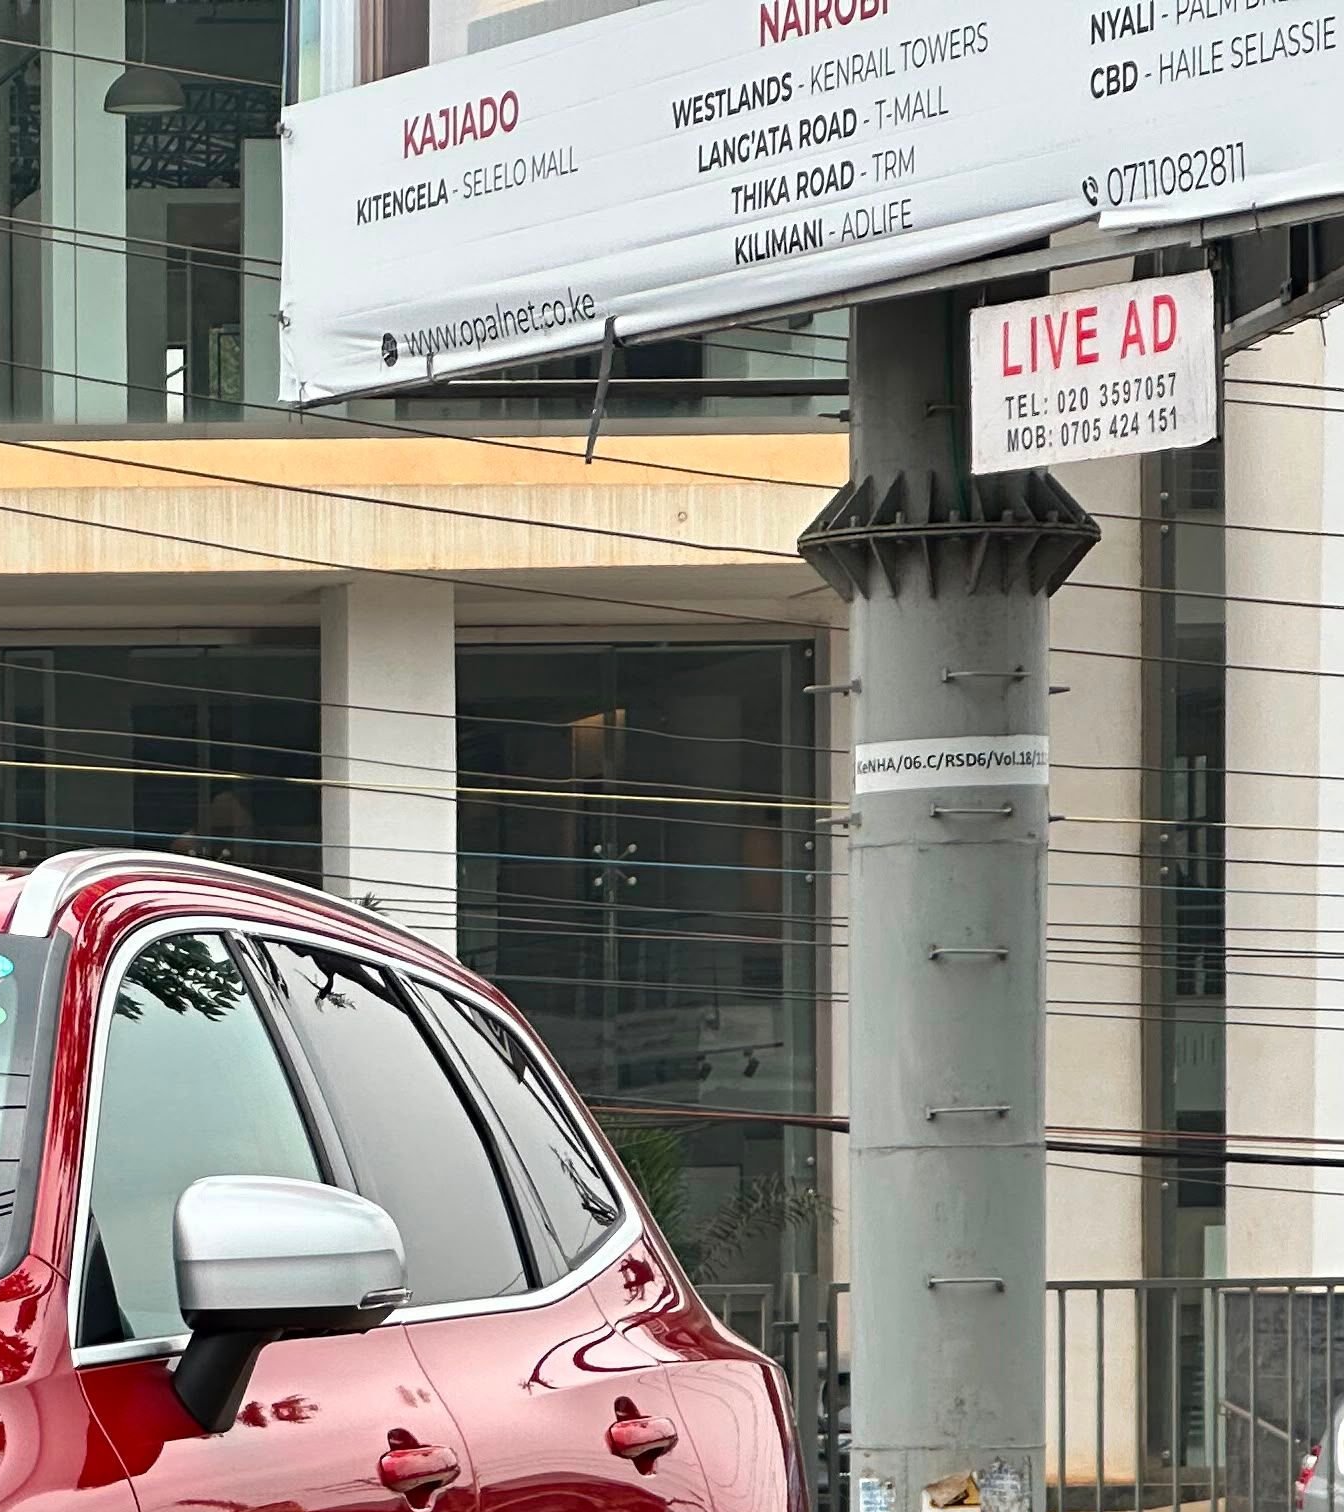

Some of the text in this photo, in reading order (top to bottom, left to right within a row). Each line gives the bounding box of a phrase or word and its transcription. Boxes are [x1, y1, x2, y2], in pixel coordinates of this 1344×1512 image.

[1090, 0, 1155, 45] NYALI
[1090, 60, 1139, 99] CBD
[1159, 40, 1224, 85] HAILE
[1230, 16, 1337, 69] SELASSIE
[672, 72, 792, 129] WESTLANDS
[811, 46, 896, 95] KENRAIL
[899, 22, 989, 71] TOWERS
[403, 90, 520, 159] KAJIADO
[698, 123, 793, 173] LANG'ATA
[799, 107, 857, 149] ROAD
[875, 85, 949, 130] T-MALL
[356, 178, 448, 226] KITENGELA
[463, 158, 526, 199] SELELO
[531, 145, 579, 183] MALL
[731, 174, 790, 215] THIKA
[796, 160, 855, 201] ROAD
[872, 145, 915, 183] TRM
[1107, 141, 1246, 207] 0711082811
[734, 218, 824, 265] KILIMANI
[841, 198, 914, 242] ADLIFE
[404, 286, 596, 356] www.opalnet.co.ke
[1002, 294, 1178, 377] LIVE AD
[1005, 372, 1177, 420] TEL: 020 3597057
[1006, 406, 1178, 452] MOB: 0705 424 151
